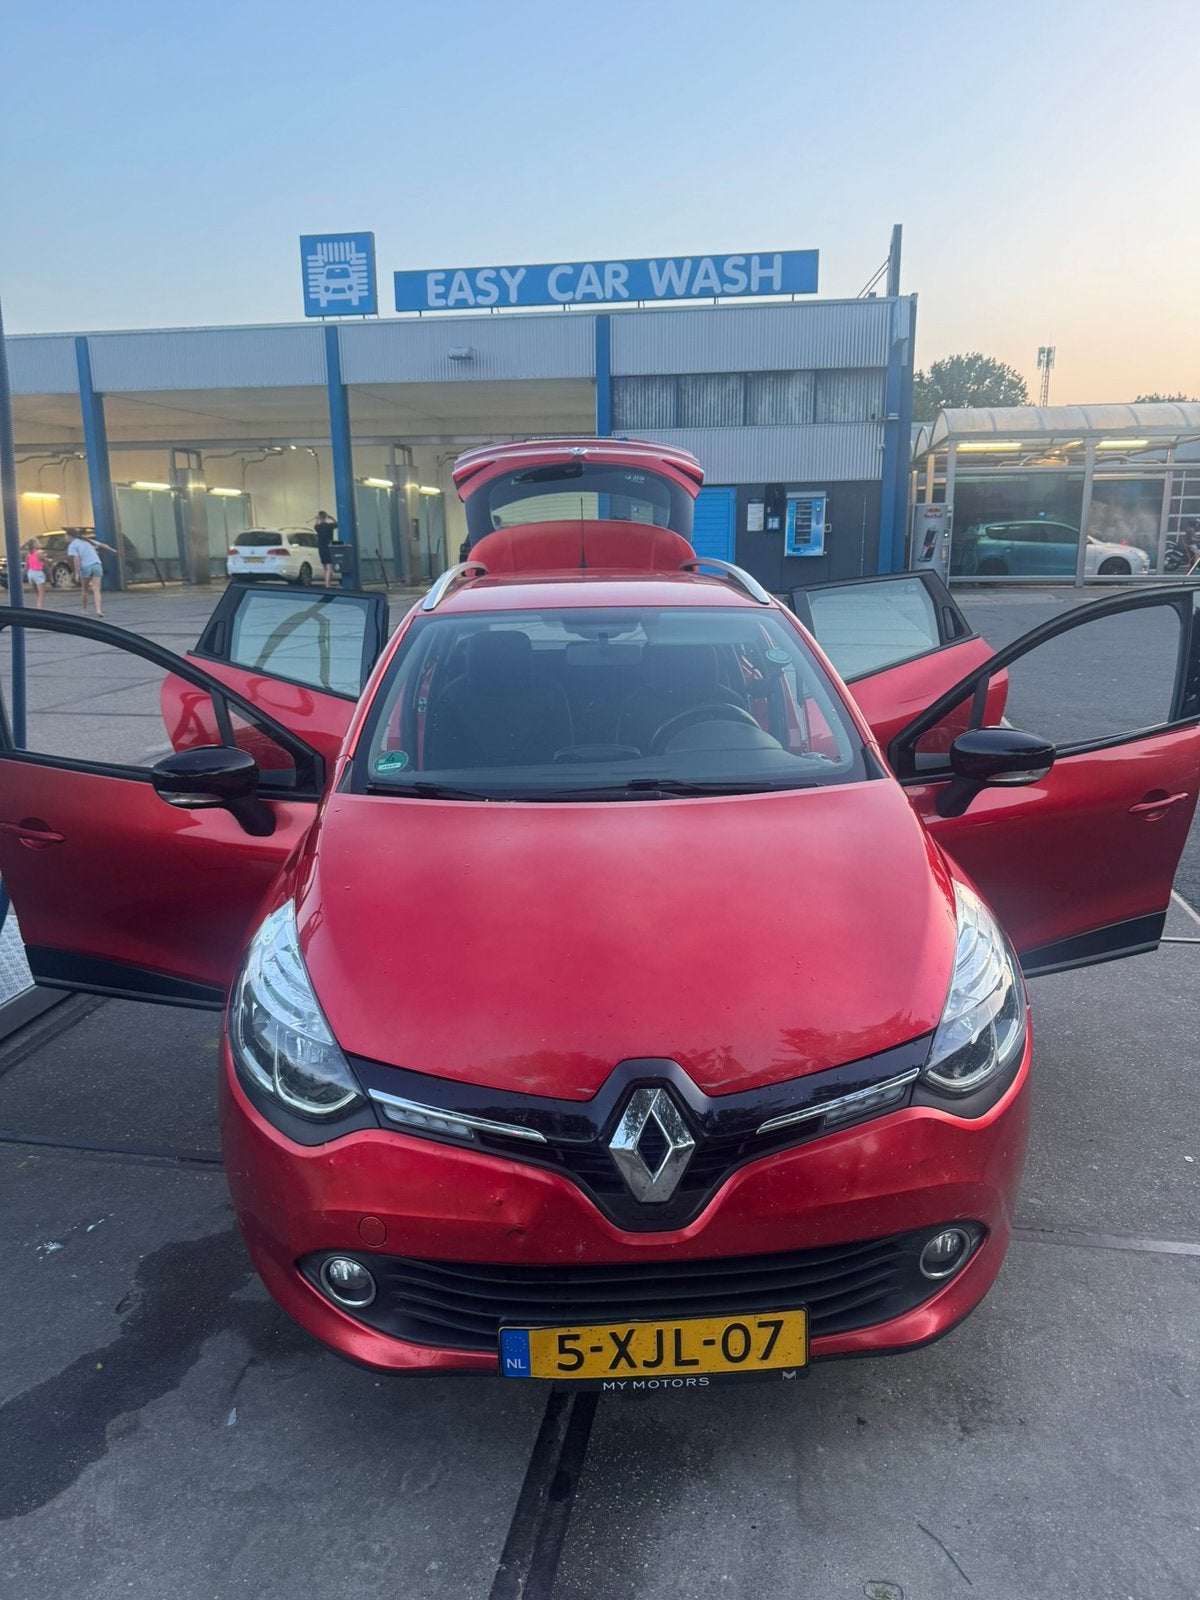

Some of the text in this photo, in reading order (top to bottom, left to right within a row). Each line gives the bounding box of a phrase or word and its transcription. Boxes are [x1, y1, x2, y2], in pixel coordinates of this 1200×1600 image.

[427, 254, 782, 307] EASY CAR WASH
[506, 1319, 785, 1371] NL 5-XJL-07
[603, 1377, 710, 1390] MY MOTORS
